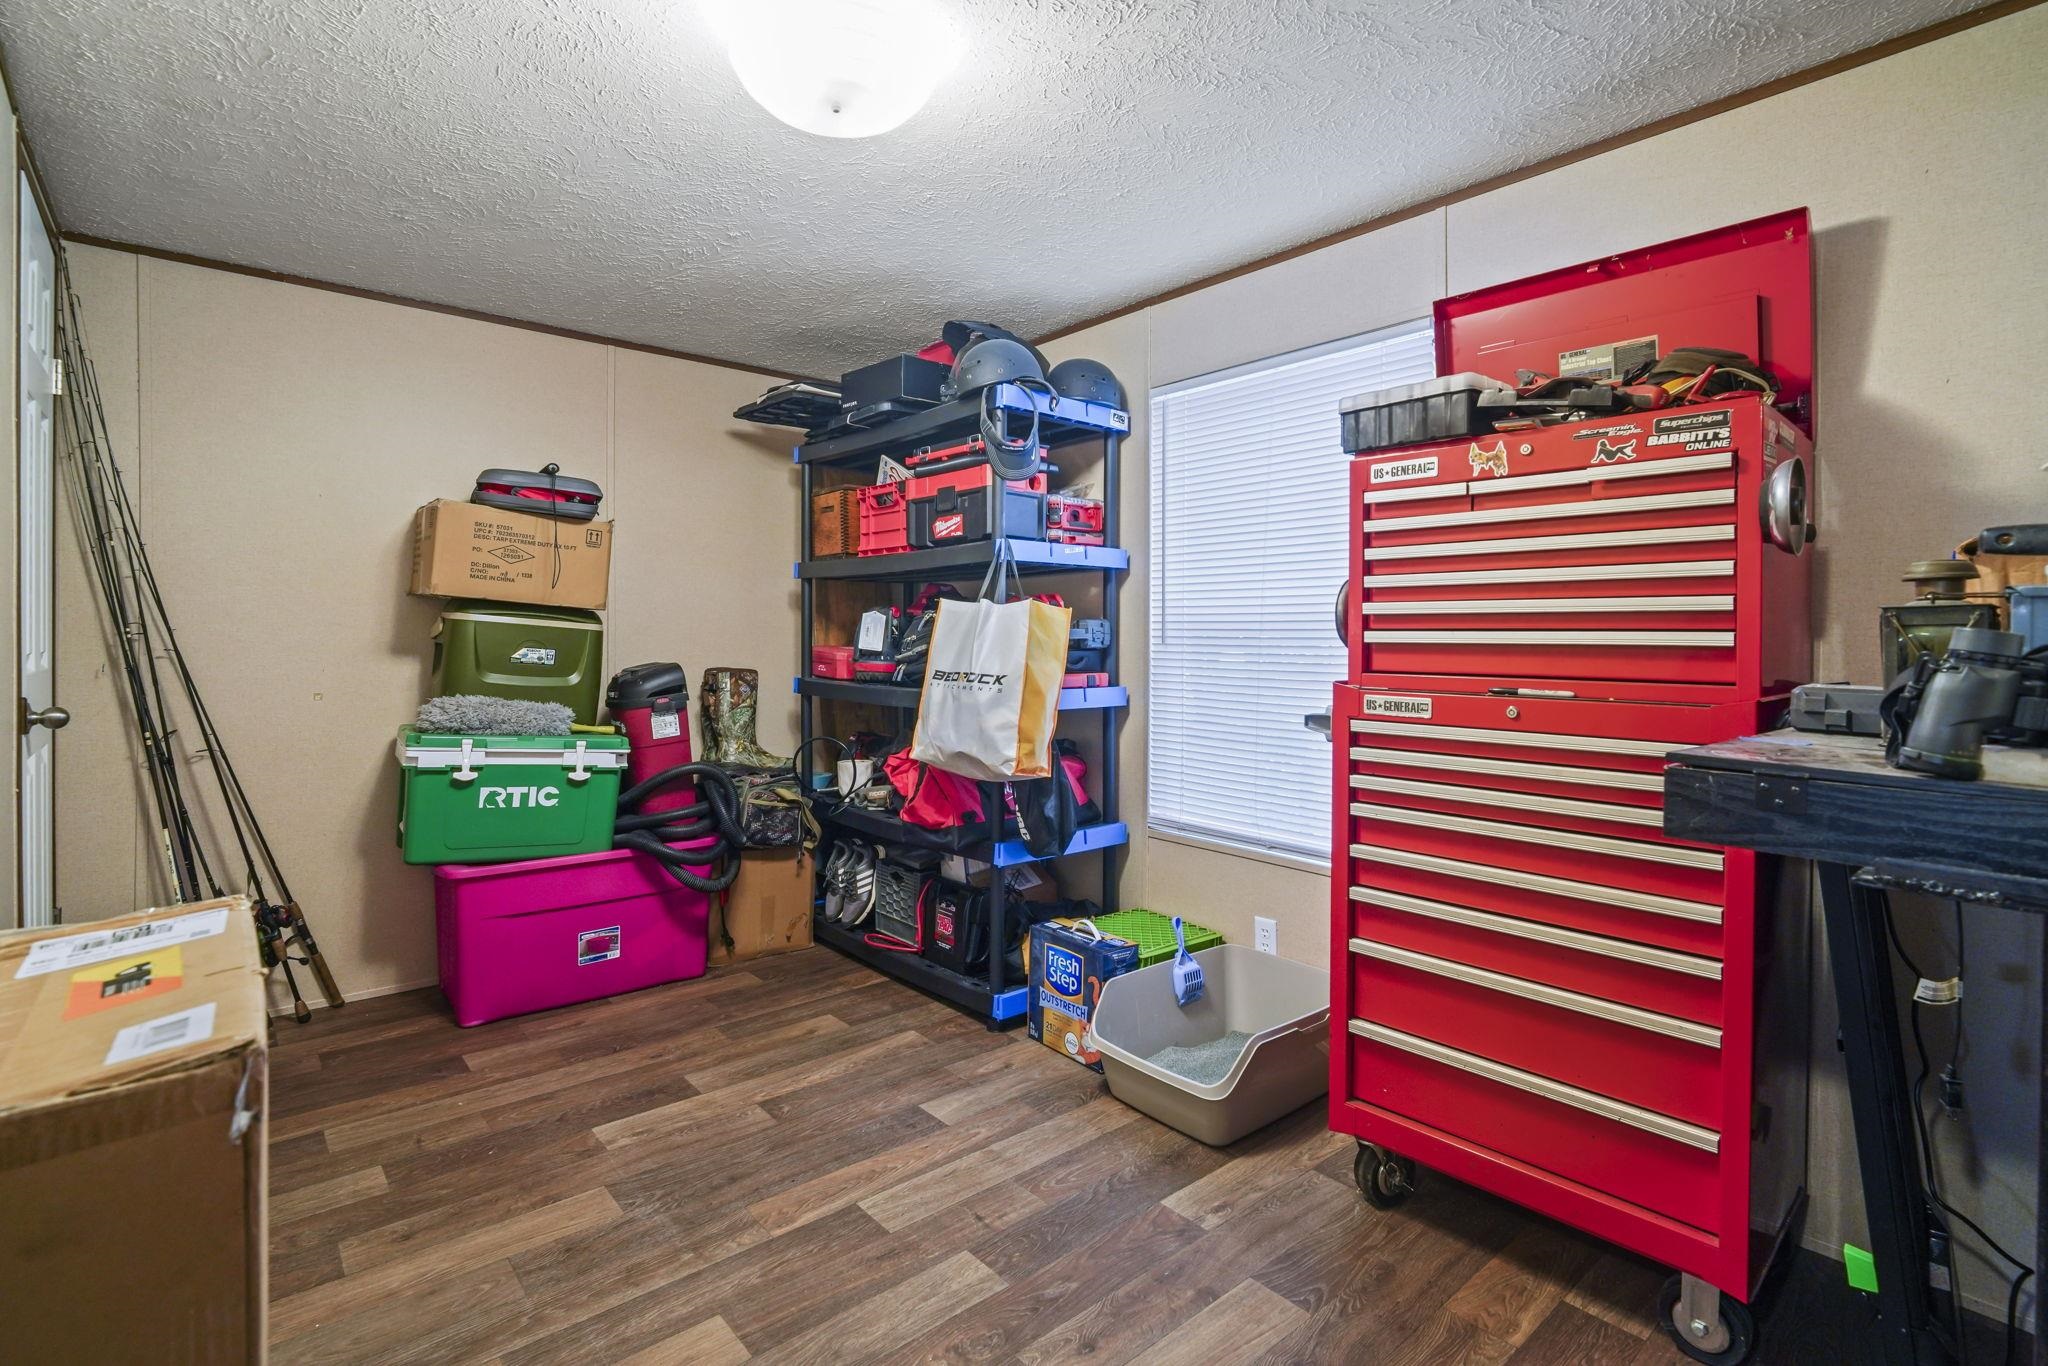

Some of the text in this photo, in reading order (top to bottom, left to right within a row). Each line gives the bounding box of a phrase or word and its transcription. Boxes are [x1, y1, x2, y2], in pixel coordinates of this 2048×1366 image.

[1659, 414, 1724, 428] Superchips
[1647, 428, 1730, 446] BABBITT'S
[1685, 439, 1730, 450] ONLINE
[1374, 468, 1384, 479] US
[1391, 463, 1427, 477] GENERAL
[509, 537, 536, 546] EXTREME
[1366, 700, 1377, 710] US
[1384, 700, 1421, 713] GENERAL
[479, 786, 560, 808] RTIC
[1048, 950, 1080, 976] Fresh
[1049, 967, 1078, 993] Step
[1041, 990, 1086, 1019] OUTSTRETCH
